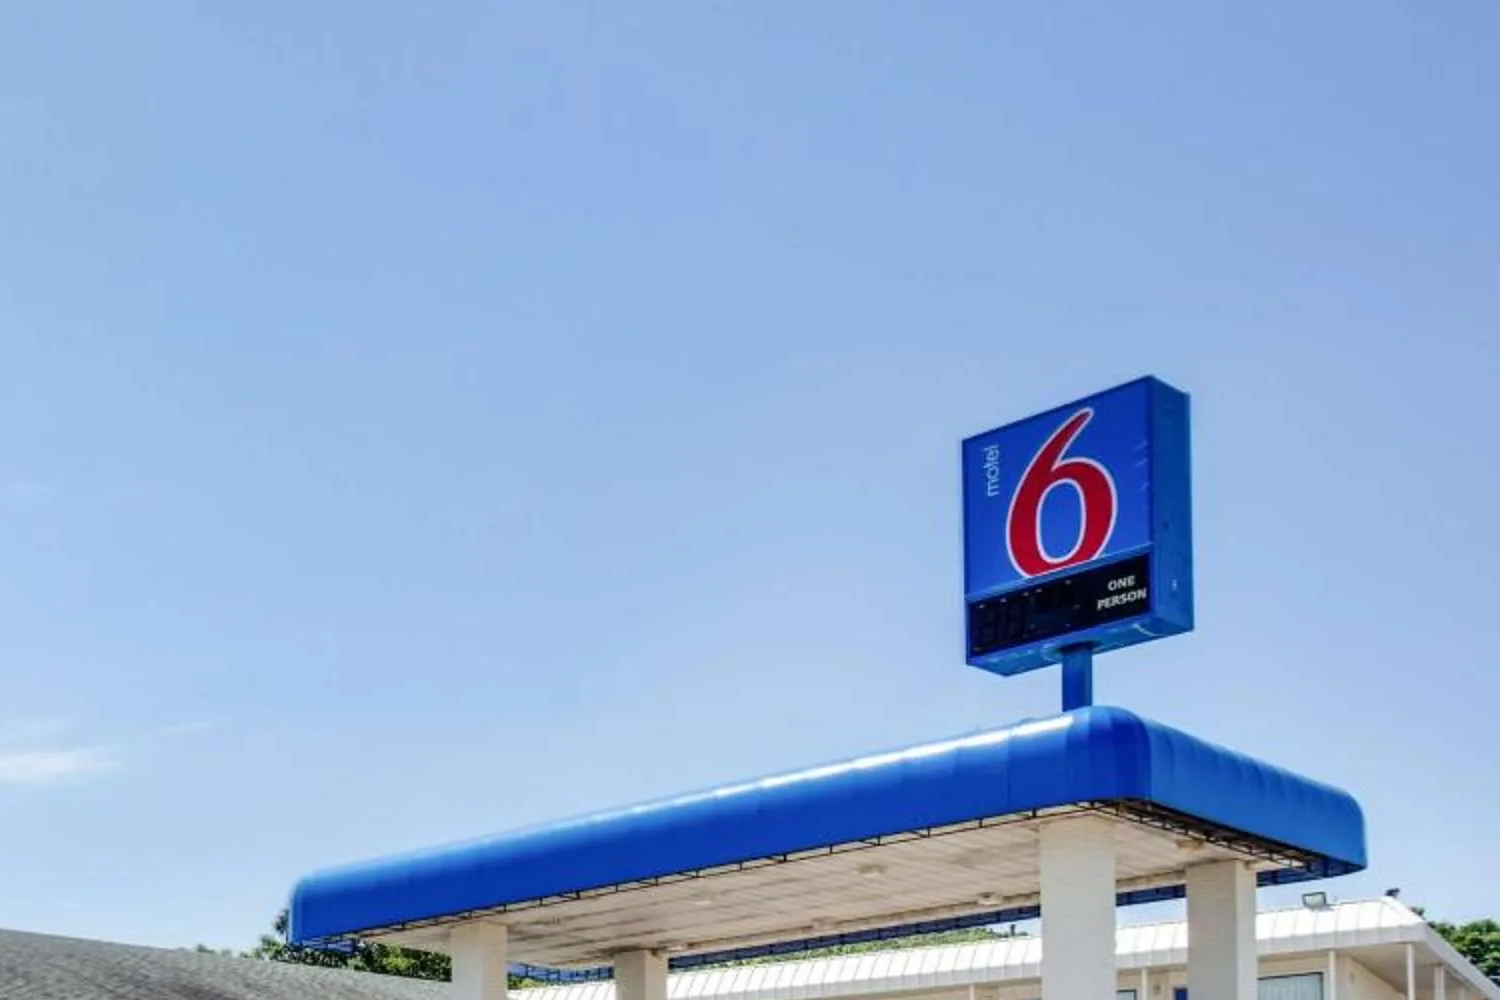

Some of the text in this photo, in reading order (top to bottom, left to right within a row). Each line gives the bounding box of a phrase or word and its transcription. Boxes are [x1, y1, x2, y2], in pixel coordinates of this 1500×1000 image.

[983, 407, 1117, 578] motel 6
[1107, 575, 1136, 591] ONE
[1097, 587, 1147, 611] PERSON
